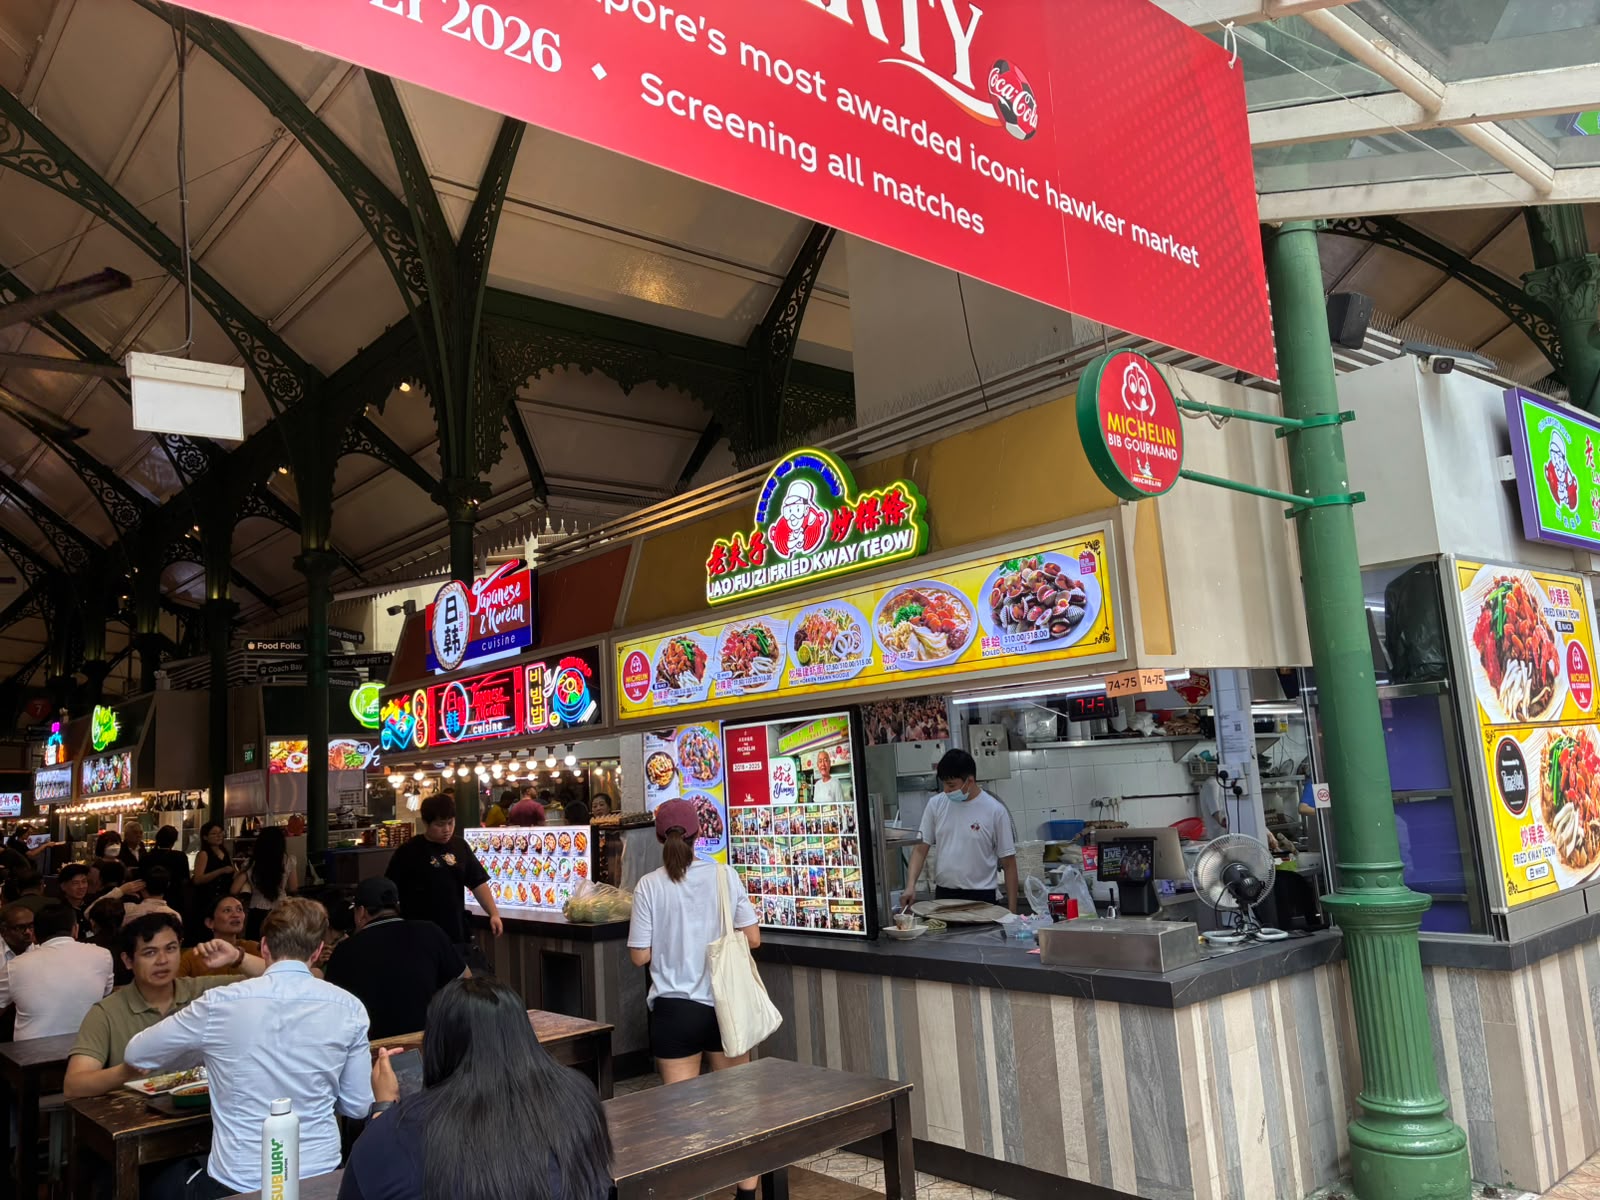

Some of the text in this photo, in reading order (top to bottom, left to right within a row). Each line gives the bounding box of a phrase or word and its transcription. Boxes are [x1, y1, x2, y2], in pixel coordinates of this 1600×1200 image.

[442, 0, 562, 73] 2026
[640, 72, 985, 234] Screening all matches
[740, 41, 827, 102] most
[837, 87, 962, 164] awarded
[970, 143, 1040, 200] iconic
[1045, 179, 1126, 236] hawker
[1131, 223, 1200, 268] market
[1107, 411, 1177, 447] MICHELIN
[1107, 433, 1178, 461] BIB GOURMAND
[1133, 476, 1162, 487] MICHELIN
[706, 577, 733, 598] LAO
[770, 557, 811, 581] FRIED
[812, 543, 859, 570] KWAY
[860, 529, 914, 557] TEOW
[470, 578, 521, 617] Japanese
[489, 603, 525, 633] Korean
[343, 632, 358, 641] Street
[481, 634, 516, 651] cuisine
[1004, 630, 1048, 643] $10.00/$18.00
[257, 642, 301, 650] Food Folks
[982, 645, 1028, 657] BOILED COCKLES
[268, 663, 302, 673] Coach Bay
[351, 658, 366, 667] Ayer
[1108, 677, 1137, 691] 74-75
[1142, 674, 1164, 685] 74-75
[529, 668, 545, 725] 비빔밥
[473, 721, 503, 734] cuisine
[773, 782, 795, 798] Yummy
[1103, 850, 1121, 859] LIVE
[1513, 847, 1556, 865] FRIED KWAY TEOW
[271, 1138, 284, 1200] SUBWAY
